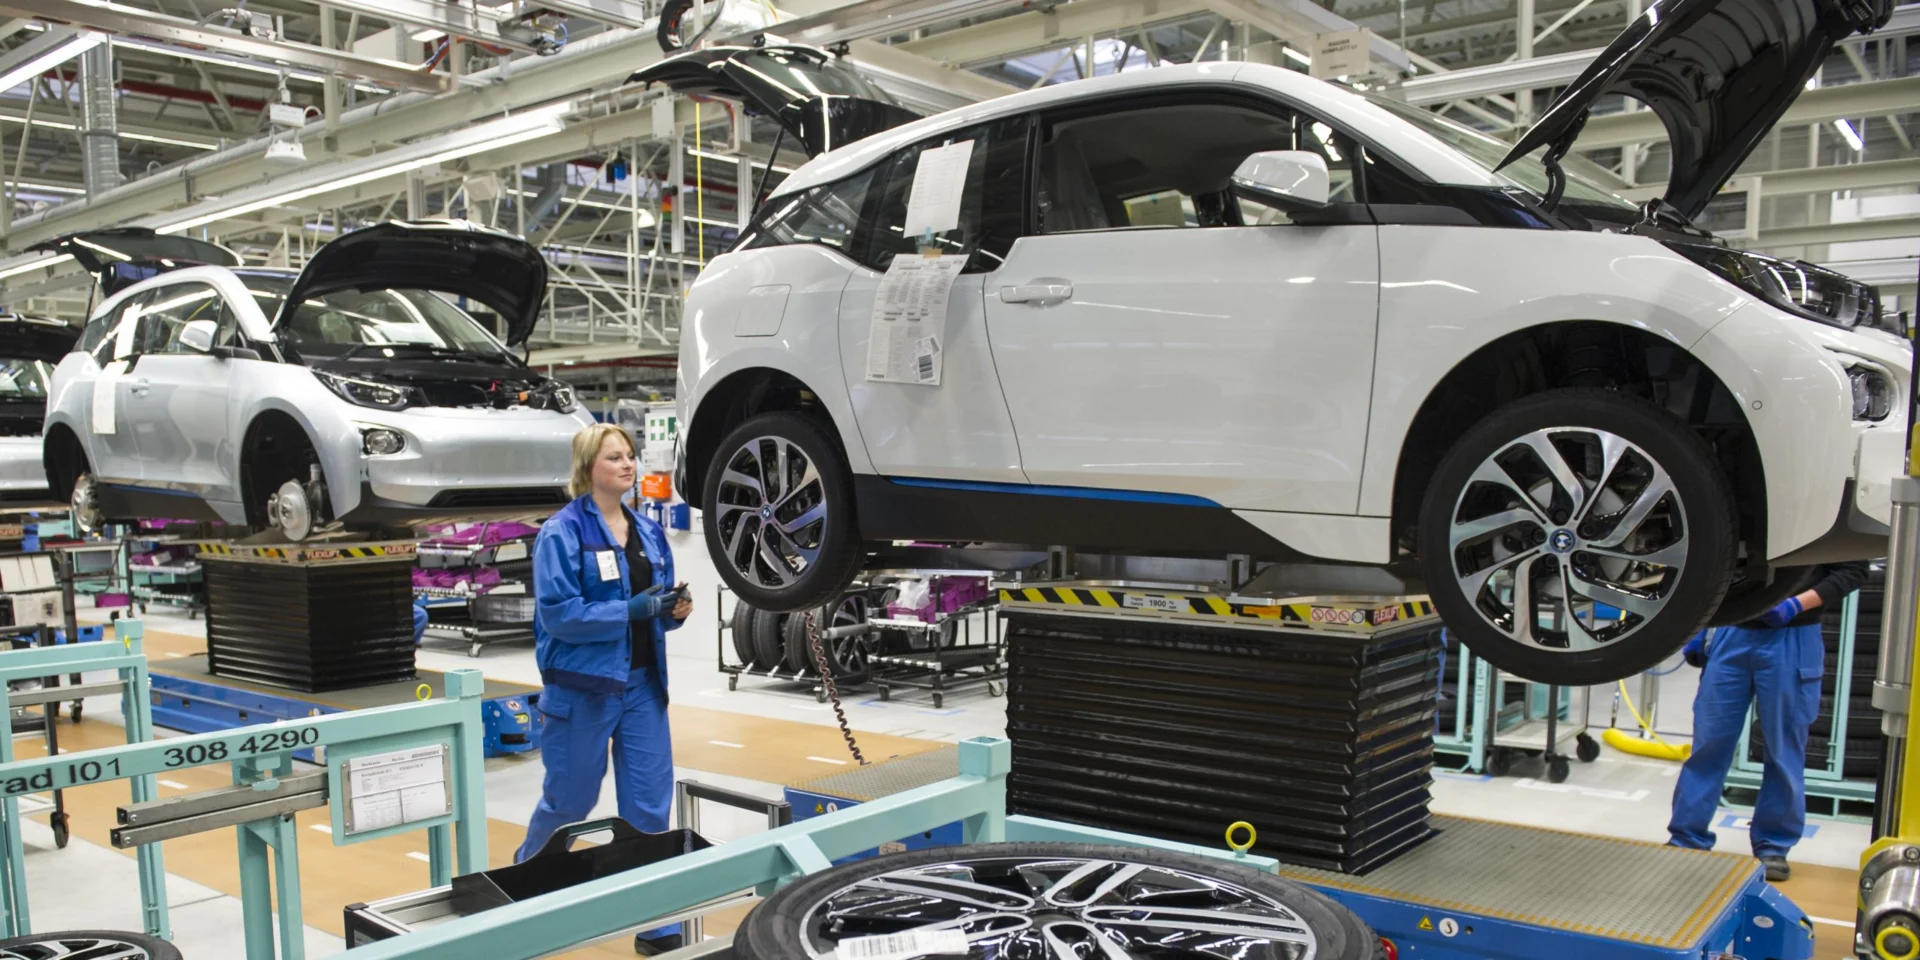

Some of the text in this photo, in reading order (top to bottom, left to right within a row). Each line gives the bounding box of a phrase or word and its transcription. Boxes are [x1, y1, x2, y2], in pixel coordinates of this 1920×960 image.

[1149, 599, 1167, 608] 1900
[164, 741, 229, 768] 308
[239, 727, 320, 754] 4290
